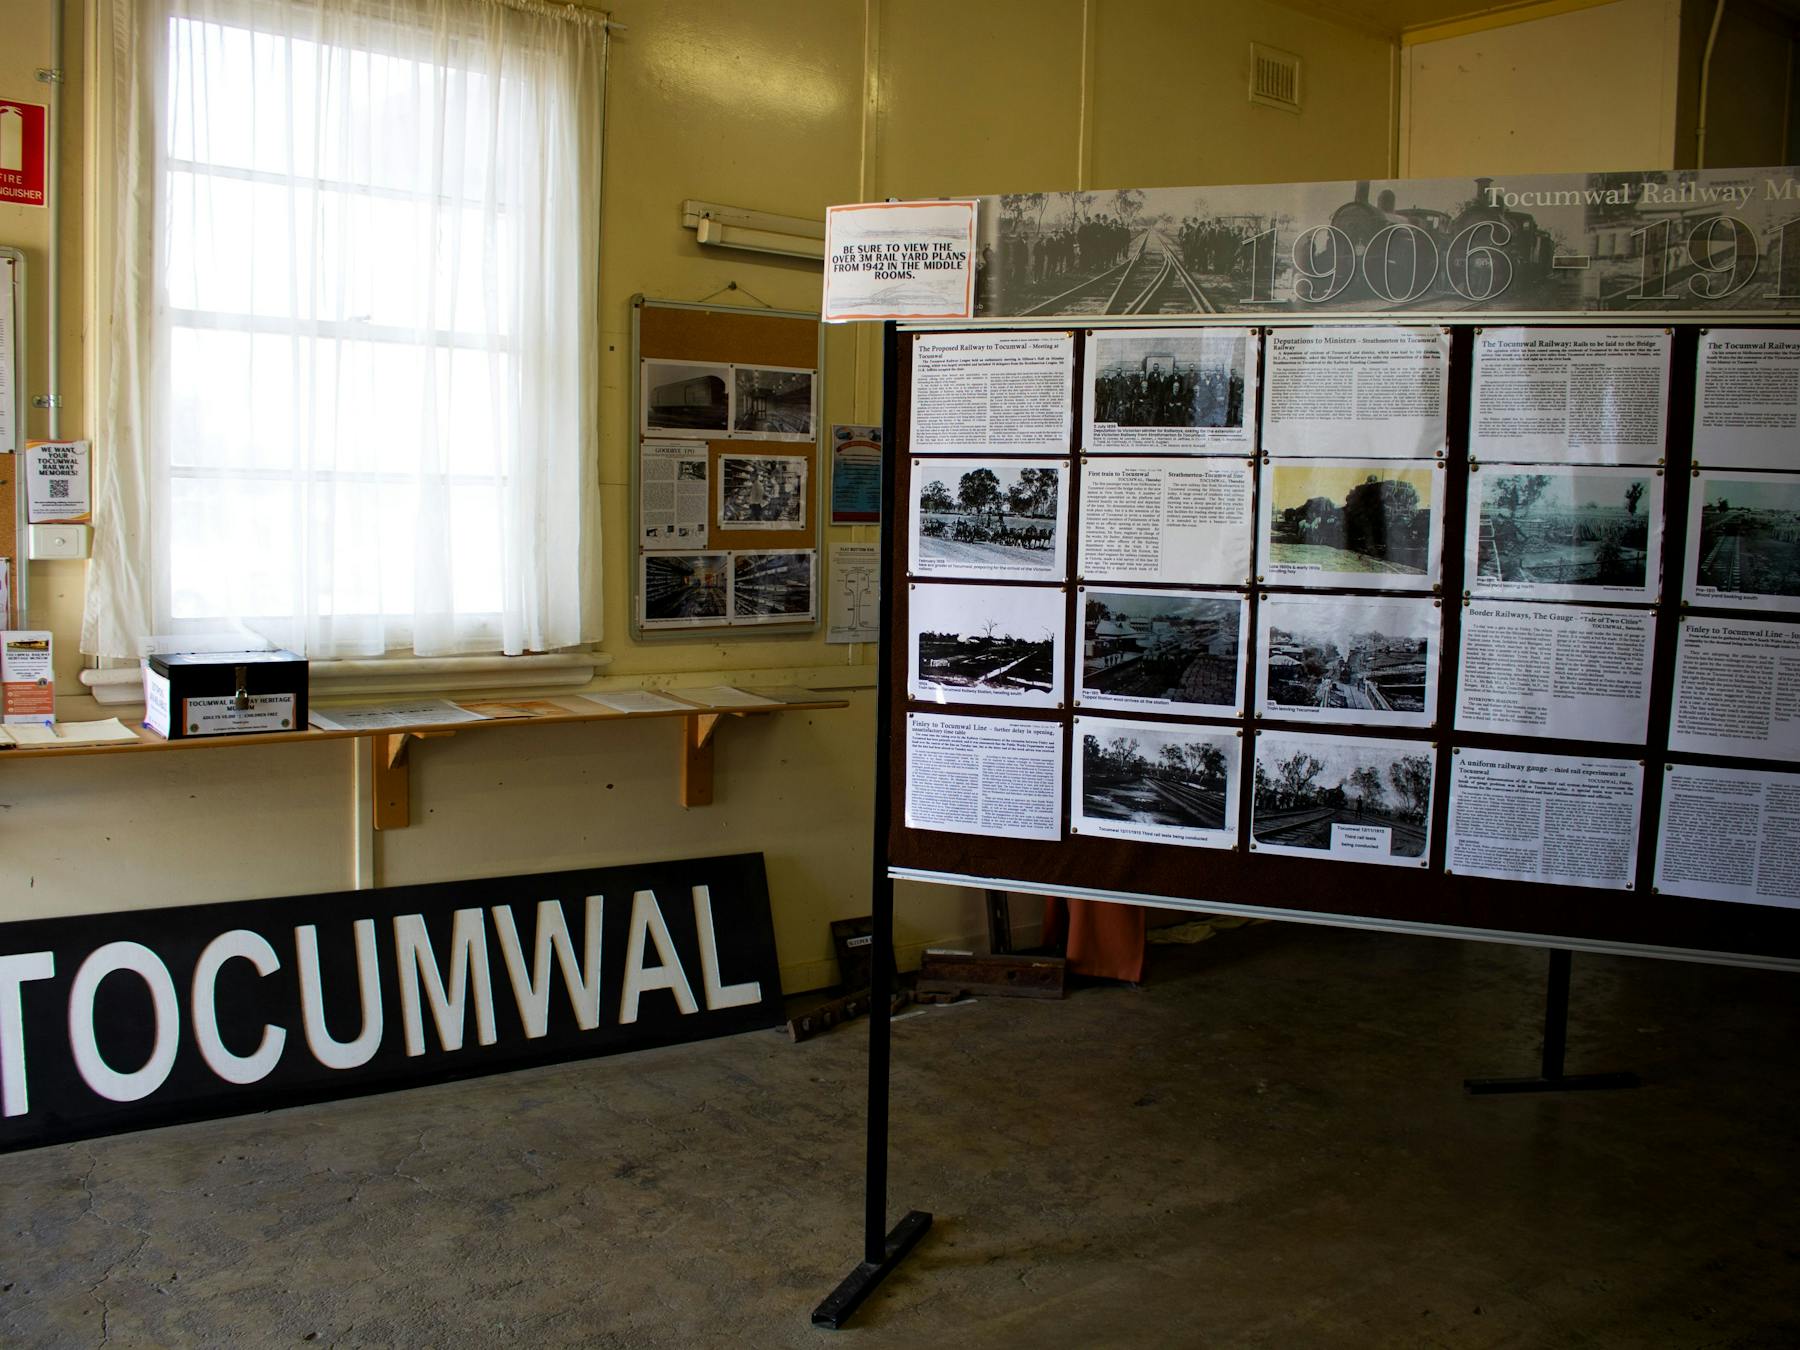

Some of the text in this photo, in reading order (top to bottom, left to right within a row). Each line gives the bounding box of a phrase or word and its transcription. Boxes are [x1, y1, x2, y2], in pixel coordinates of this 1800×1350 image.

[1484, 184, 1630, 208] Tocumwal
[1640, 181, 1754, 209] Railway
[844, 243, 952, 254] BE SURE TO VIEW THE
[832, 252, 966, 263] OVER 3M RAIL YARD PLANS
[1240, 220, 1513, 304] 1906
[834, 261, 963, 272] FROM 1942 IN THE MIDDLE
[874, 270, 916, 279] ROOMS.
[1274, 338, 1314, 346] Deputations
[931, 345, 958, 353] Proposed
[1496, 610, 1531, 619] Railways,
[1686, 625, 1709, 634] Finley
[1722, 628, 1763, 637] Tocumwal
[1765, 630, 1782, 638] Line
[1468, 760, 1496, 768] uniform
[1497, 763, 1525, 771] railway
[0, 884, 761, 1117] TOCUMWAL
